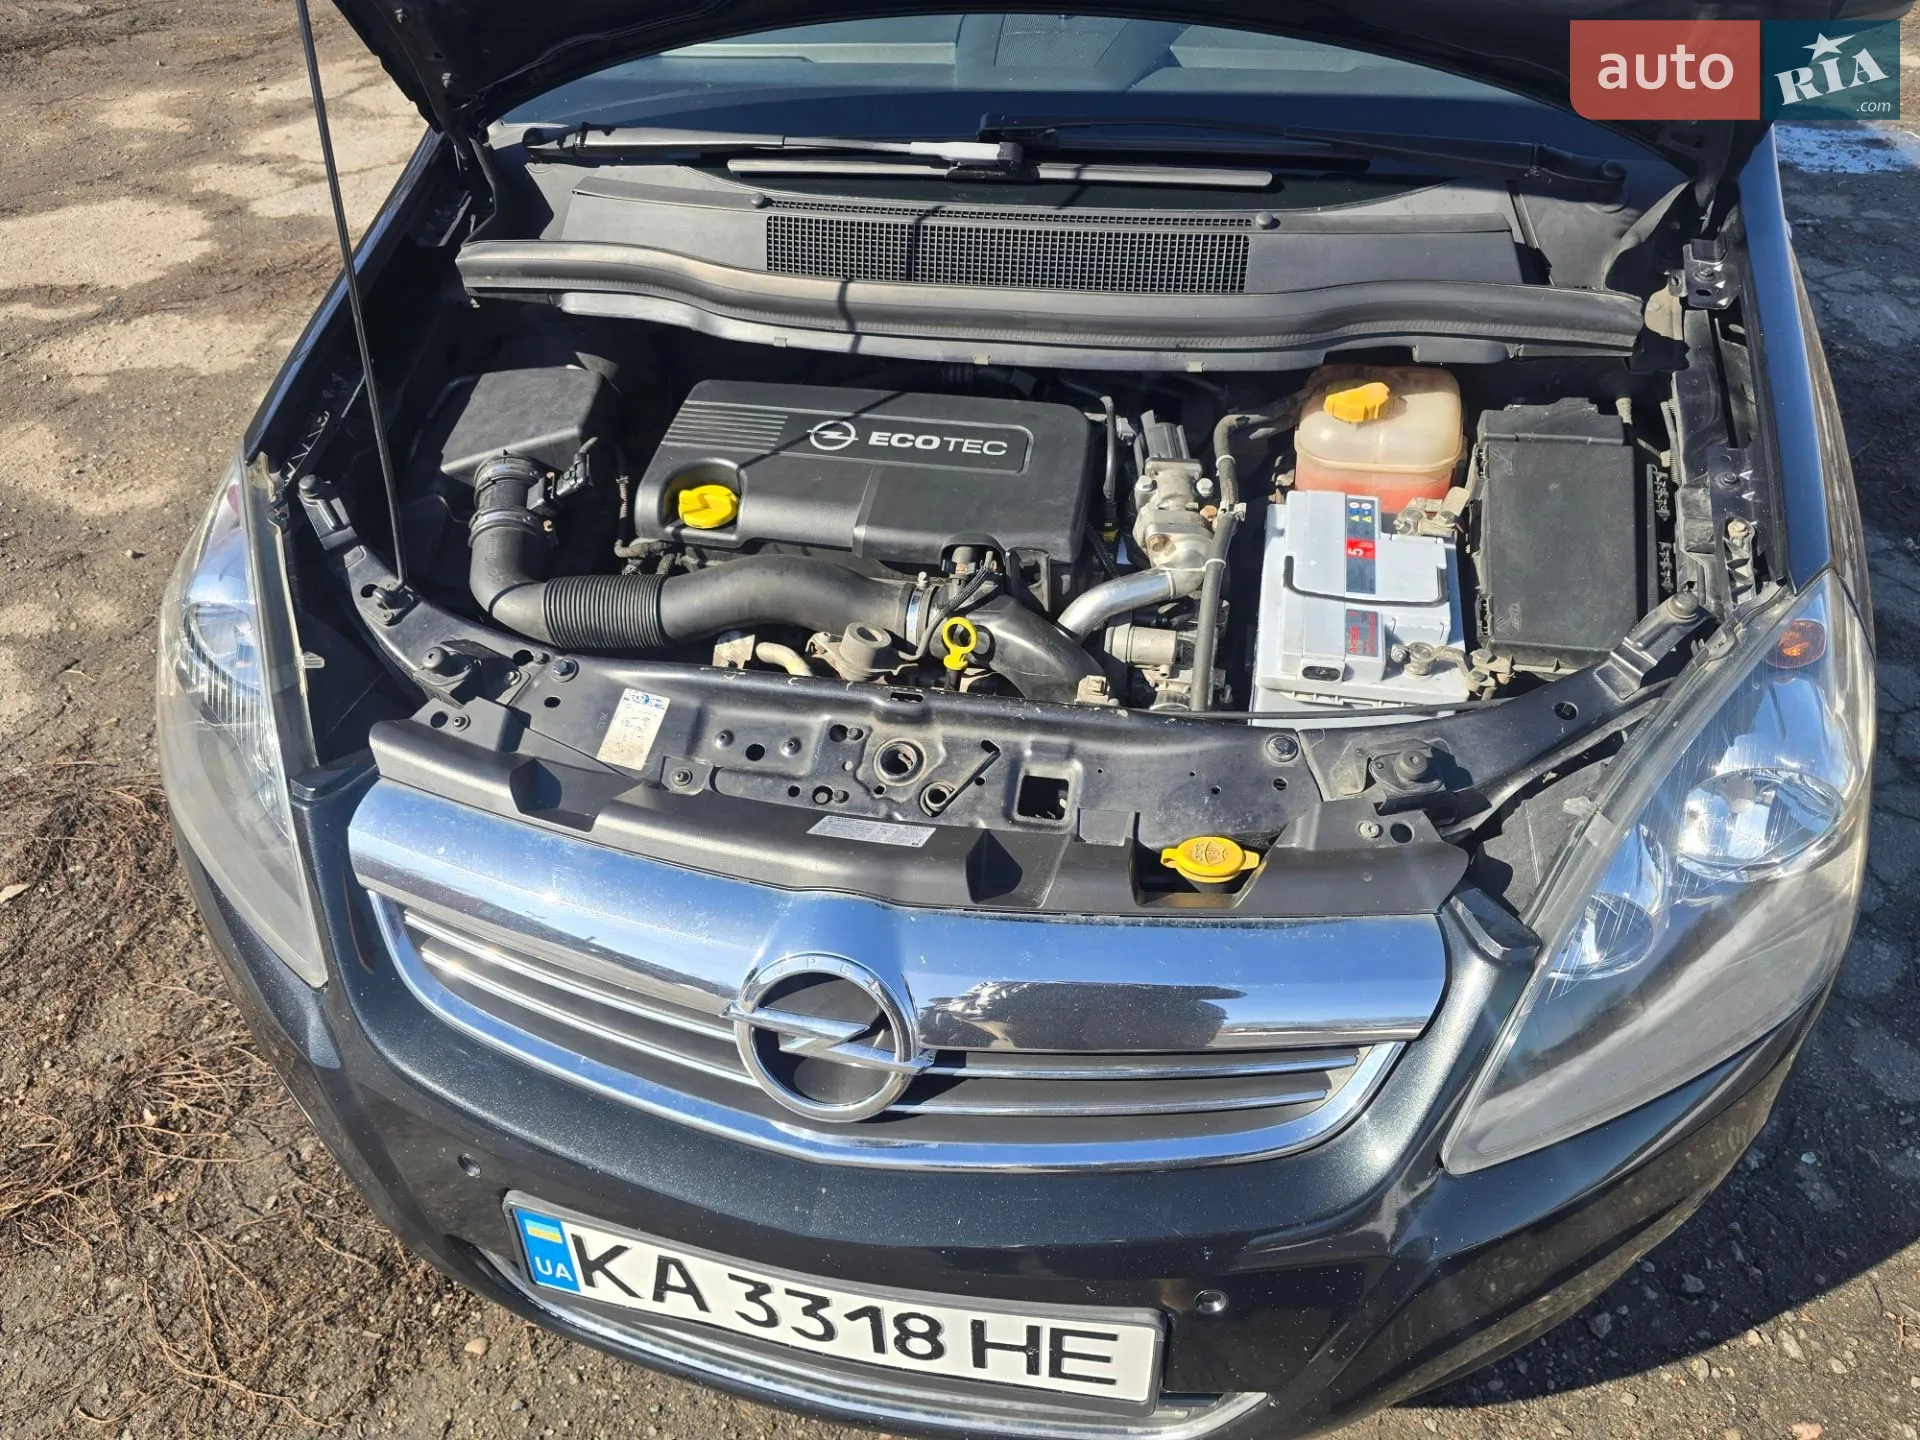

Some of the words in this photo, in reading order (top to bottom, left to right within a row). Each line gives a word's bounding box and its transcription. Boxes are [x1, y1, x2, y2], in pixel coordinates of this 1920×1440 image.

[868, 431, 1009, 456] ECOTEC
[534, 1256, 574, 1283] UA
[570, 1232, 713, 1314] KA
[727, 1272, 946, 1361] 3318
[970, 1318, 1120, 1386] HE
